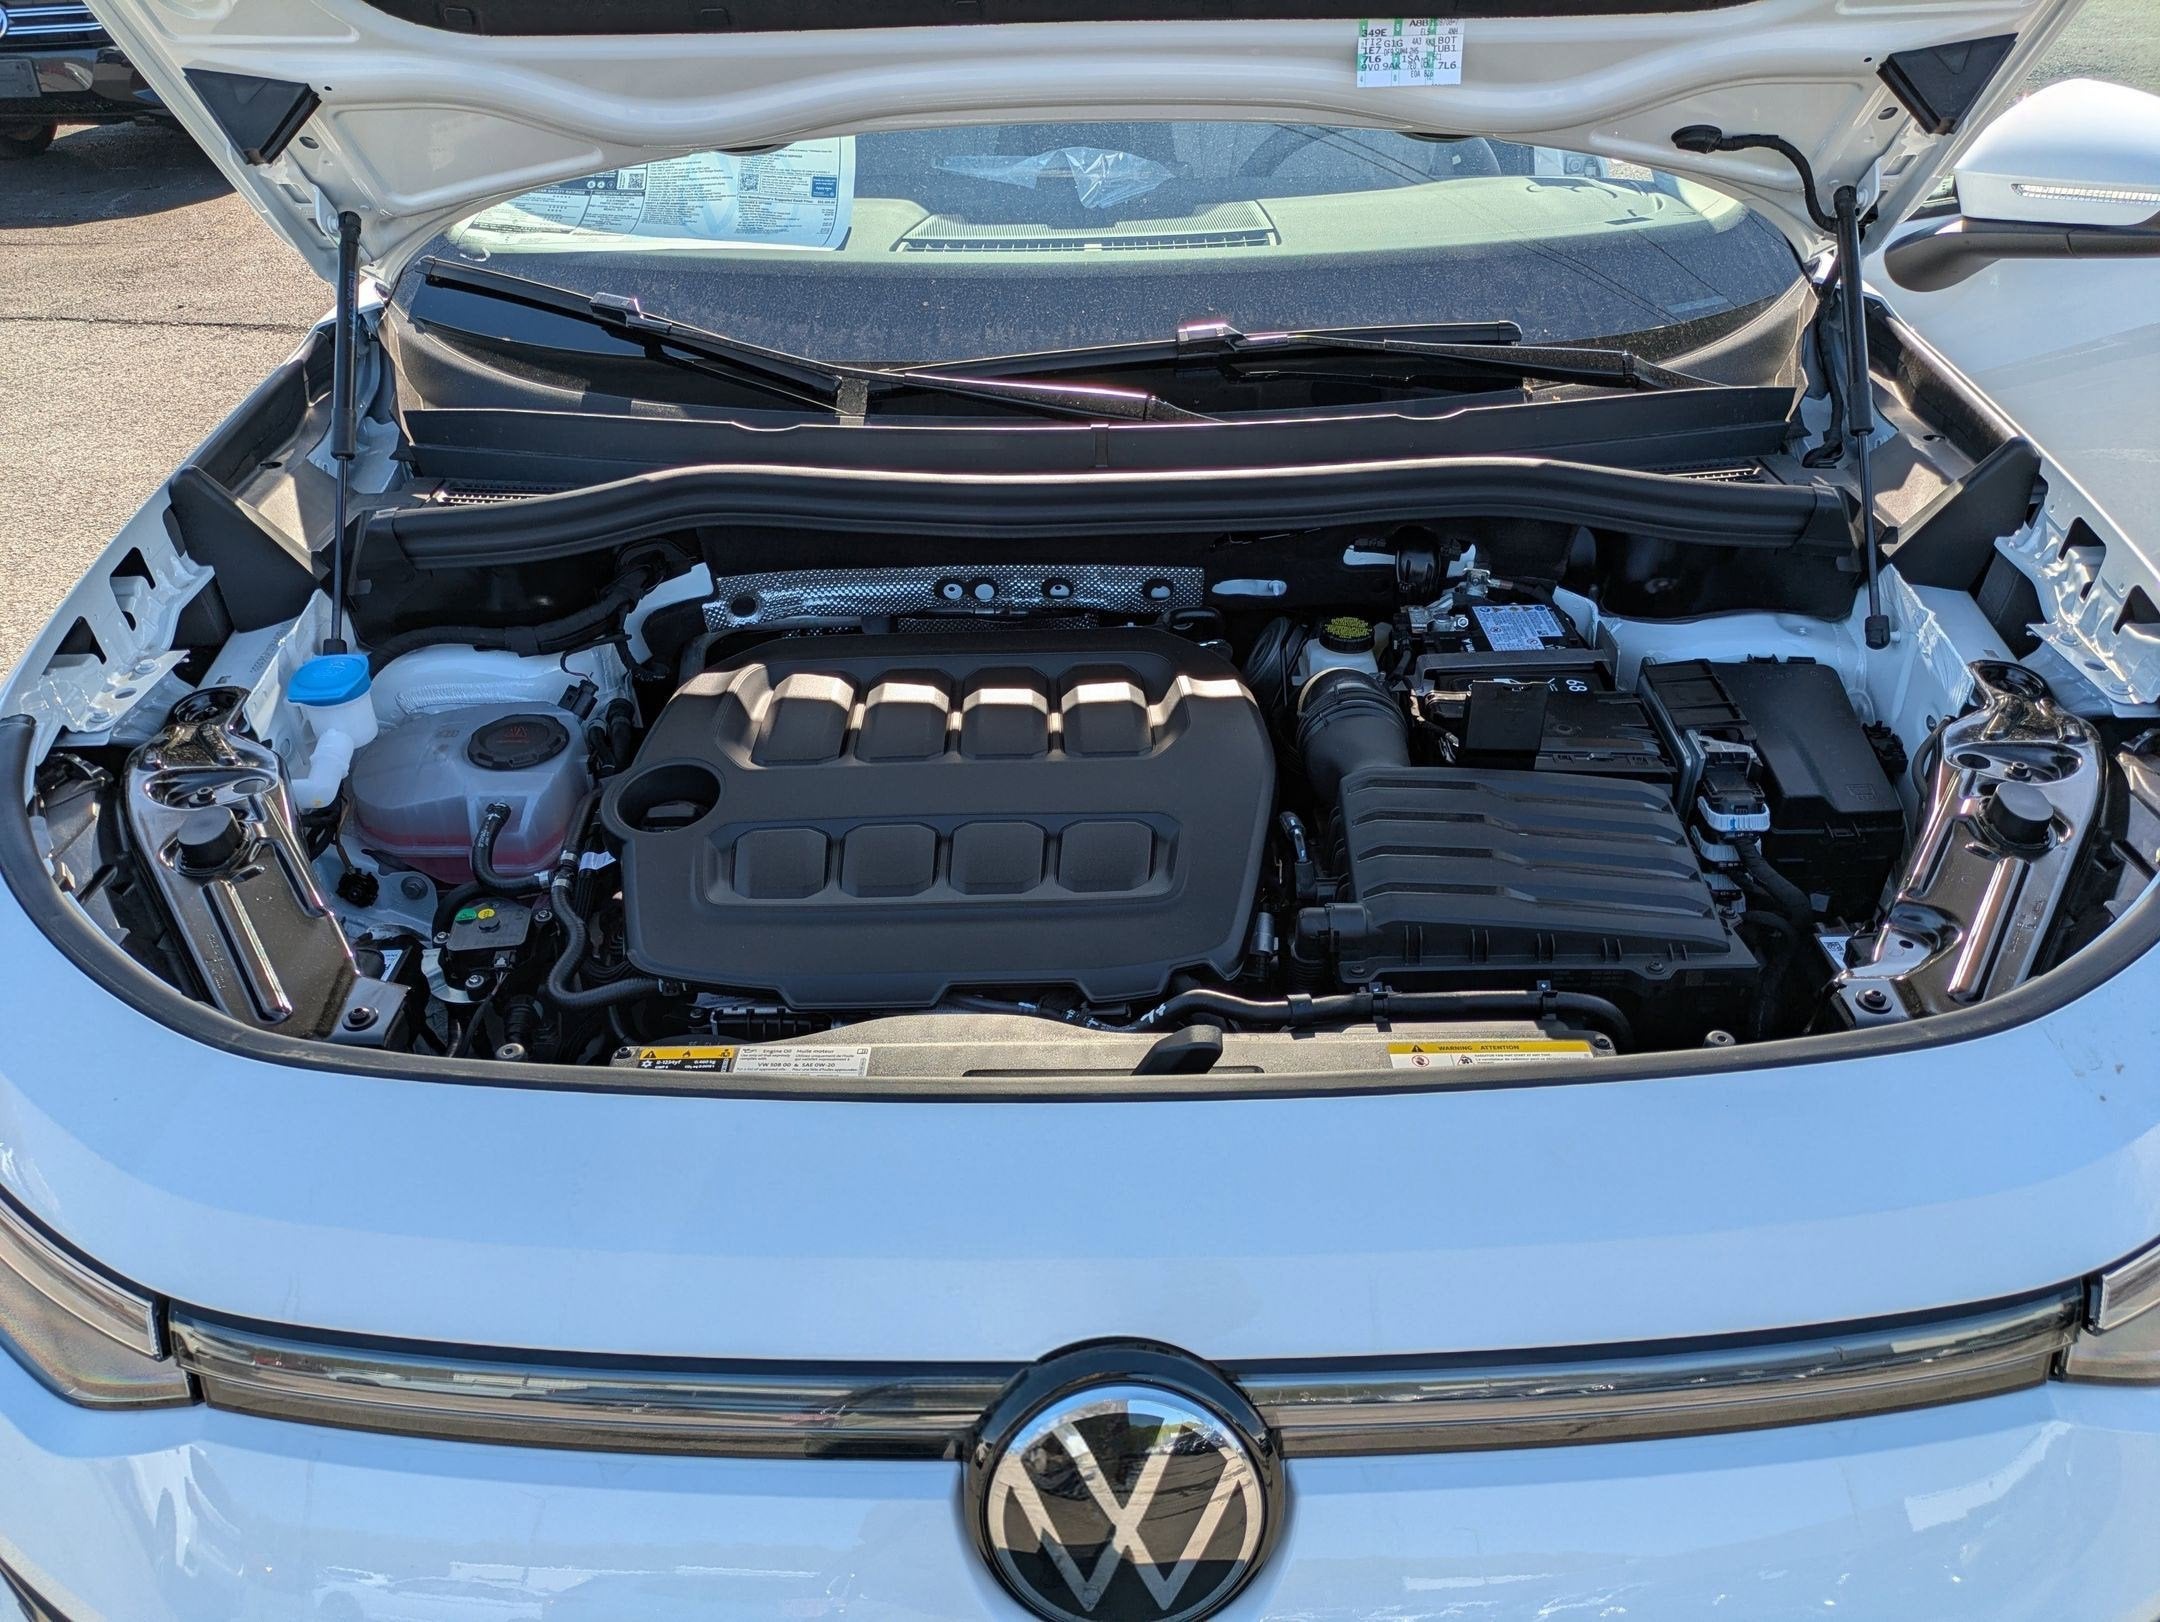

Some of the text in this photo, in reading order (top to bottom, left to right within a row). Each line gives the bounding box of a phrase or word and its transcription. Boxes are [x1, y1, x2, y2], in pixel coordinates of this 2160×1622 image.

[1361, 28, 1387, 37] 349E
[1363, 55, 1382, 63] 7L6
[1437, 60, 1457, 70] 7L6
